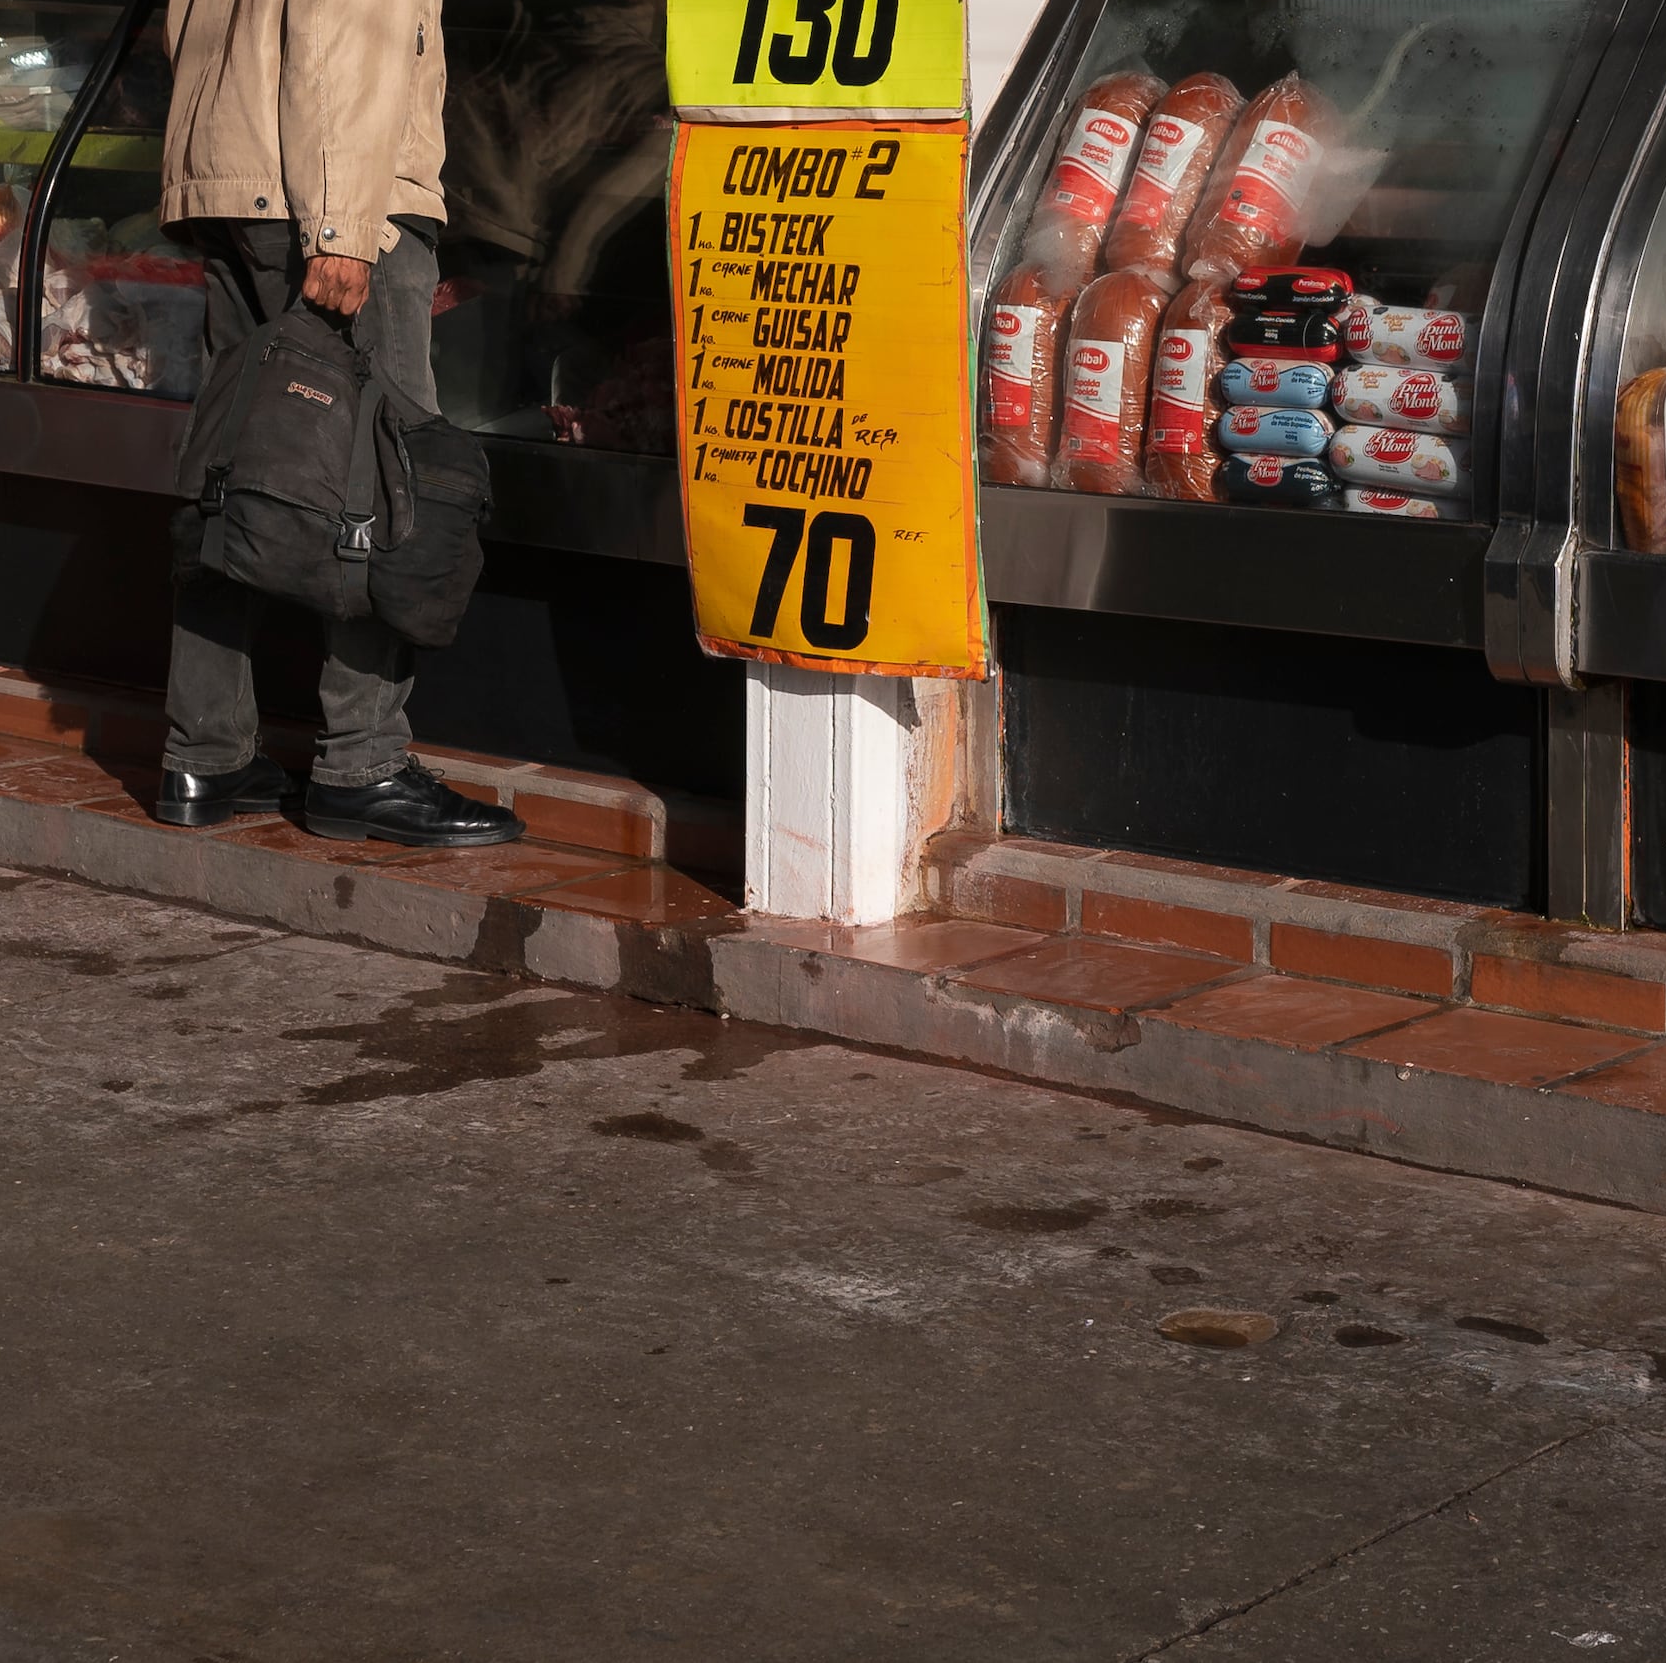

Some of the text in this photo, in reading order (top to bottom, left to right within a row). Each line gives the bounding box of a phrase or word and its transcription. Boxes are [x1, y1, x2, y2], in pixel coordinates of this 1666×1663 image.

[1090, 120, 1125, 140] Alibal
[1151, 123, 1180, 140] Alibal
[723, 145, 847, 202] COMBO
[751, 260, 860, 306] MECHAR
[1075, 352, 1103, 365] Alibal
[1403, 393, 1442, 409] Monte
[756, 449, 872, 500] COCHINO
[743, 503, 876, 650] 70
